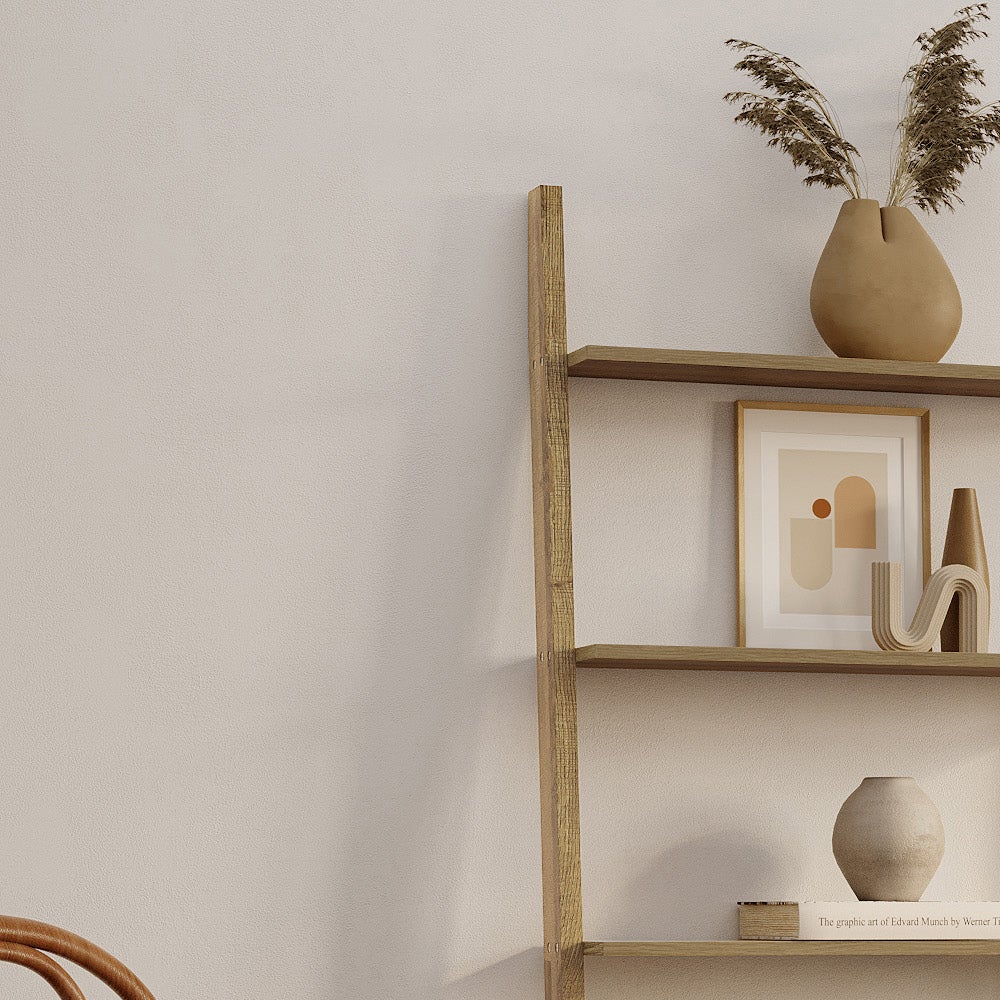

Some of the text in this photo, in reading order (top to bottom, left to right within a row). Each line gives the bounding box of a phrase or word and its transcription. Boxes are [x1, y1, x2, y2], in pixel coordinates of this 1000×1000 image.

[819, 917, 834, 926] The
[836, 917, 865, 929] graphic
[867, 918, 878, 926] art
[880, 916, 889, 926] of
[891, 917, 919, 926] Edvard
[921, 917, 949, 926] Munch
[950, 917, 960, 928] by
[963, 917, 991, 926] Werner
